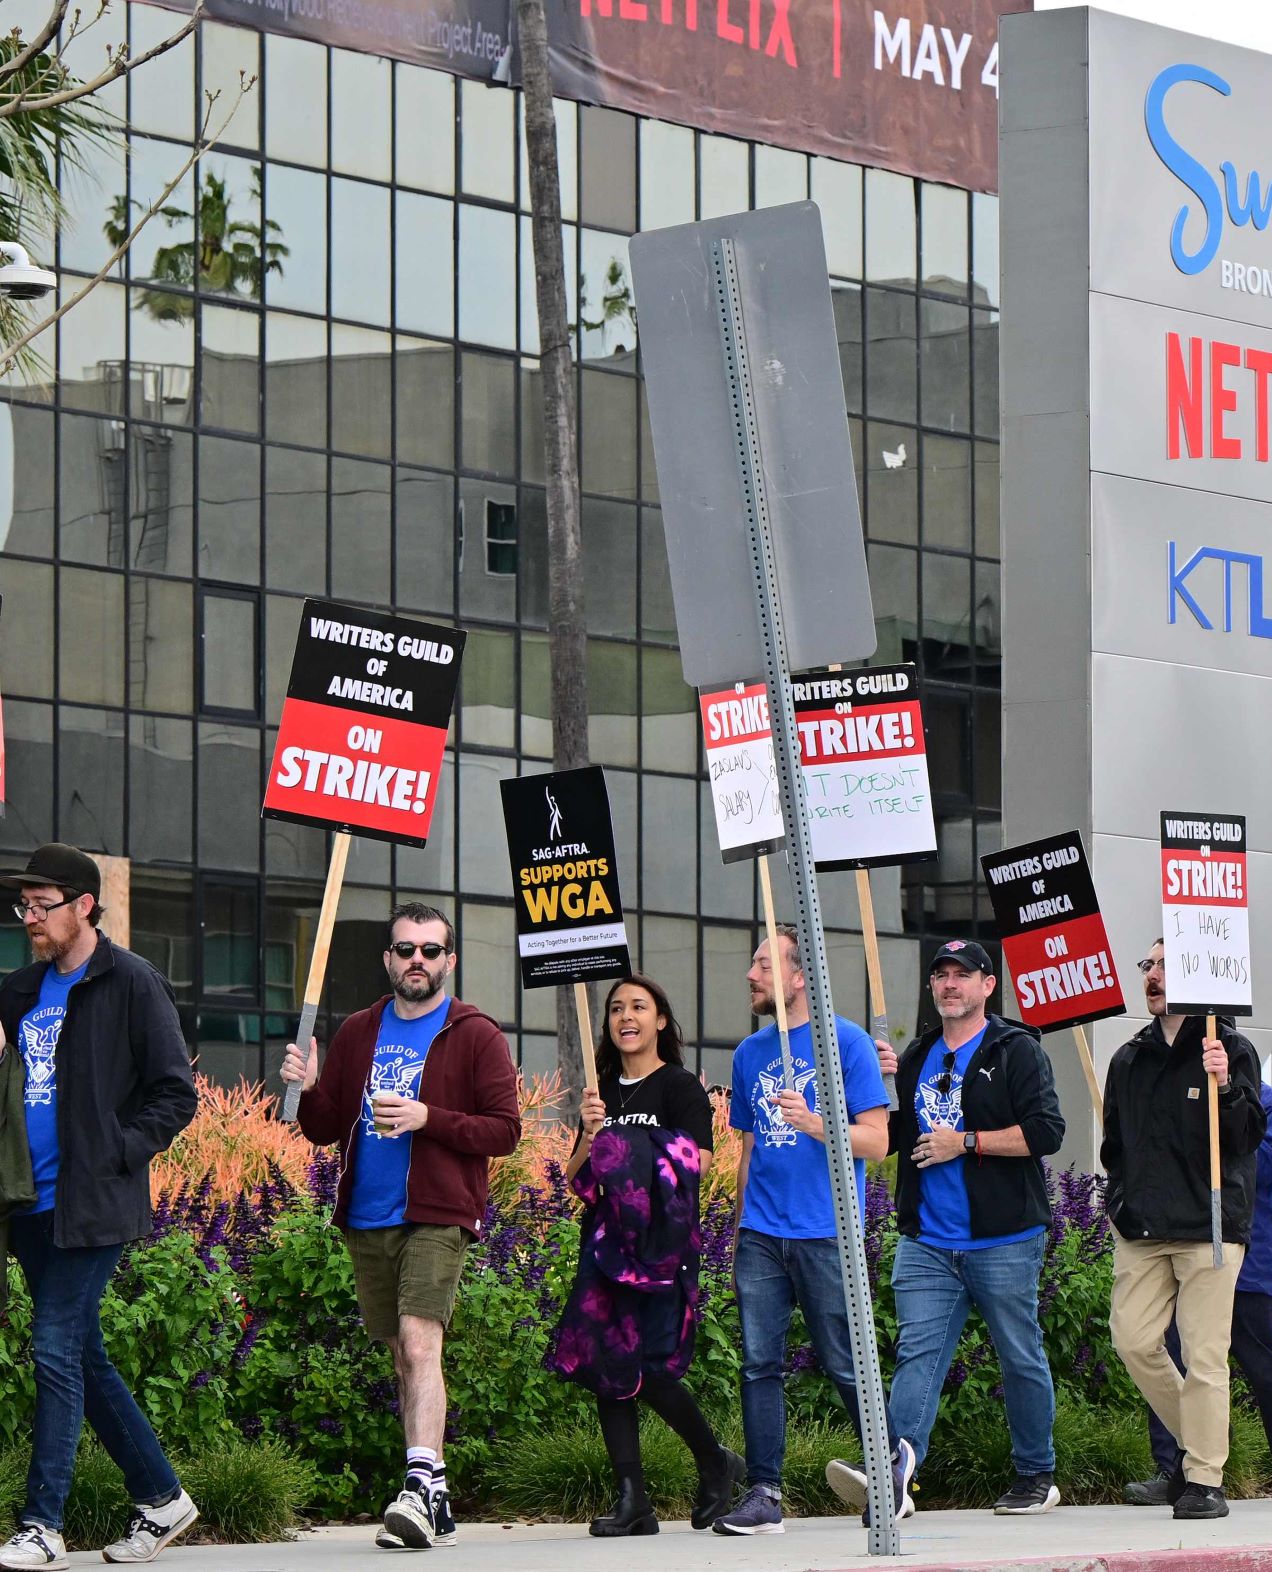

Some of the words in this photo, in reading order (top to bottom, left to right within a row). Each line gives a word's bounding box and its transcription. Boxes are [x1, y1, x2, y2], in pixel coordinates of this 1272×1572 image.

[427, 8, 473, 59] Project
[473, 21, 502, 62] Area
[874, 10, 973, 90] MAY
[310, 617, 395, 654] WRITERS
[397, 635, 454, 666] GUILD
[366, 657, 388, 677] OF
[327, 675, 415, 712] AMERICA
[790, 679, 853, 702] RITERS
[856, 673, 909, 696] GUILD
[835, 702, 852, 715] ON
[347, 725, 383, 755] ON
[798, 711, 915, 758] TRIKE!
[276, 746, 432, 816] STRIKE!
[868, 795, 925, 815] ITSELF
[1165, 819, 1211, 840] WRITERS
[1213, 823, 1242, 842] GUILD
[989, 857, 1042, 886] WRITERS
[1043, 846, 1080, 872] GUILD
[1200, 844, 1211, 858] ON
[520, 858, 609, 886] SUPPORTS
[1032, 879, 1045, 895] OF
[1166, 859, 1244, 900] STRIKE!
[522, 880, 614, 924] WGA
[1018, 894, 1074, 924] AMERICA
[1173, 911, 1185, 938] I
[1198, 912, 1231, 942] HAVE
[1044, 934, 1069, 959] ON
[1017, 950, 1115, 1009] STRIKE!
[1181, 953, 1200, 980] NO
[1207, 951, 1248, 985] WORDS
[32, 1006, 63, 1021] GUILD
[405, 1048, 419, 1059] OF
[795, 1058, 808, 1069] OF
